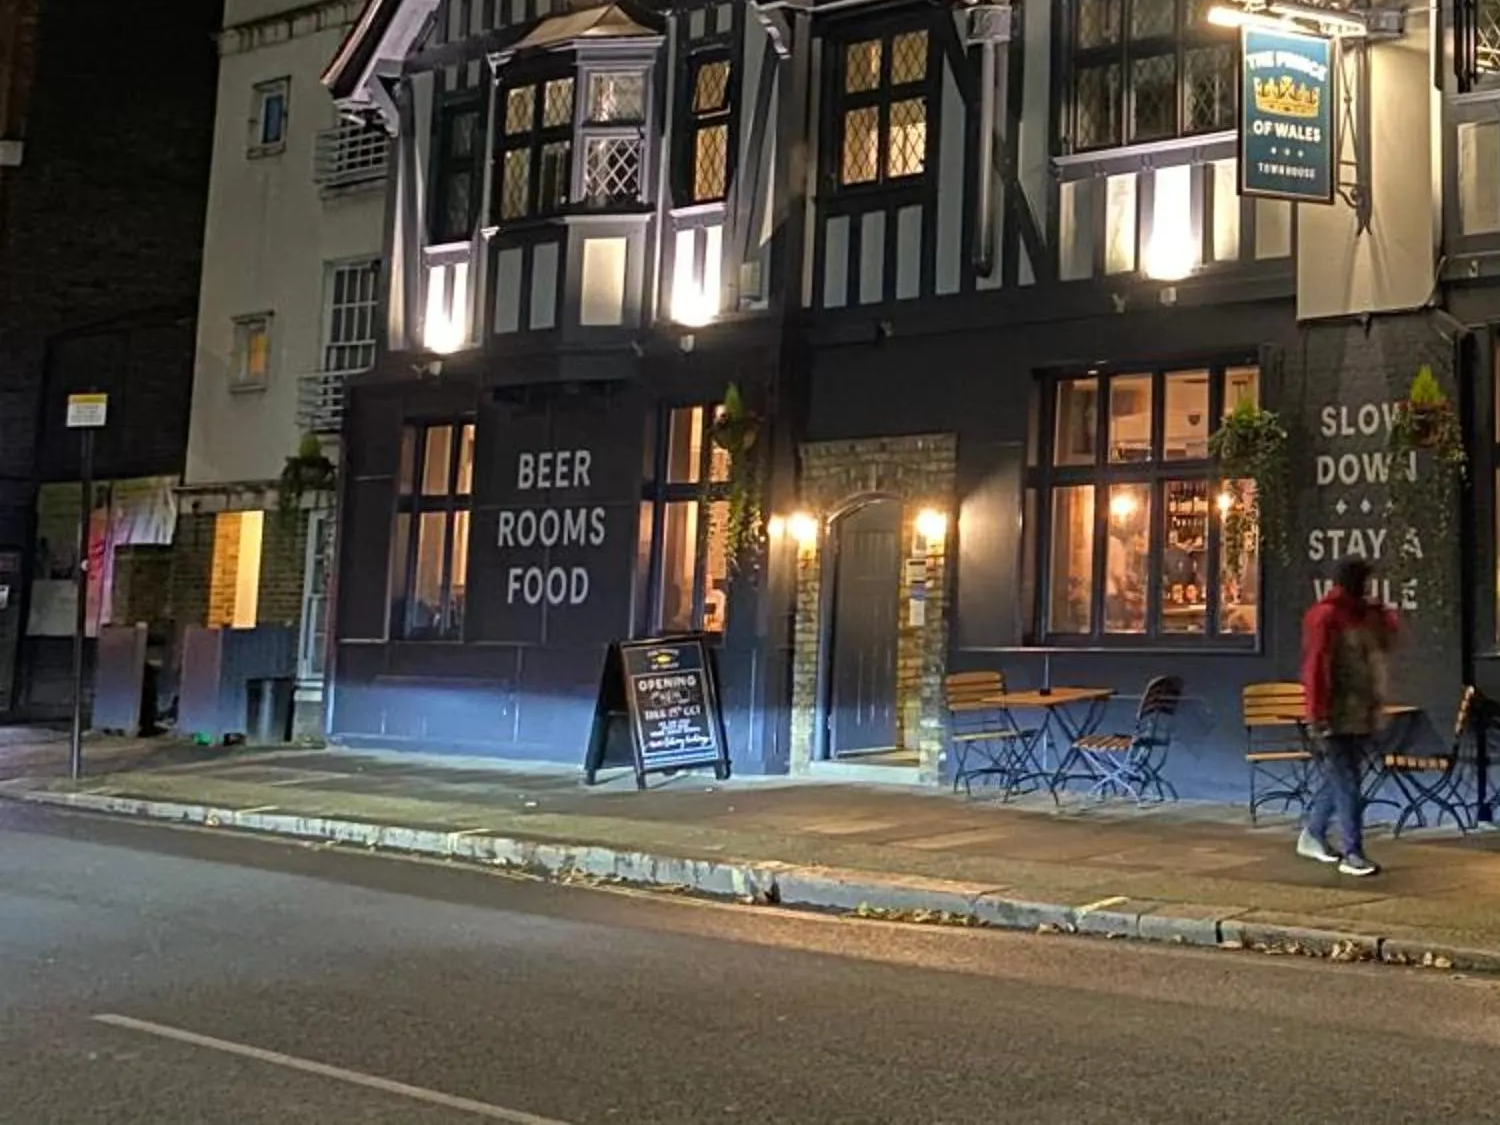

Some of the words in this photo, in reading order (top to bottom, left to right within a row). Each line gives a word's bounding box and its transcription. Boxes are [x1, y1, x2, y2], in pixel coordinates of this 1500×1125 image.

[1253, 120, 1274, 136] OF
[1274, 122, 1321, 142] WALES
[518, 450, 592, 490] BEER
[498, 507, 606, 547] ROOMS
[1308, 528, 1387, 561] STAY
[1400, 527, 1423, 559] A
[507, 567, 589, 604] FOOD
[638, 675, 697, 691] OPENING
